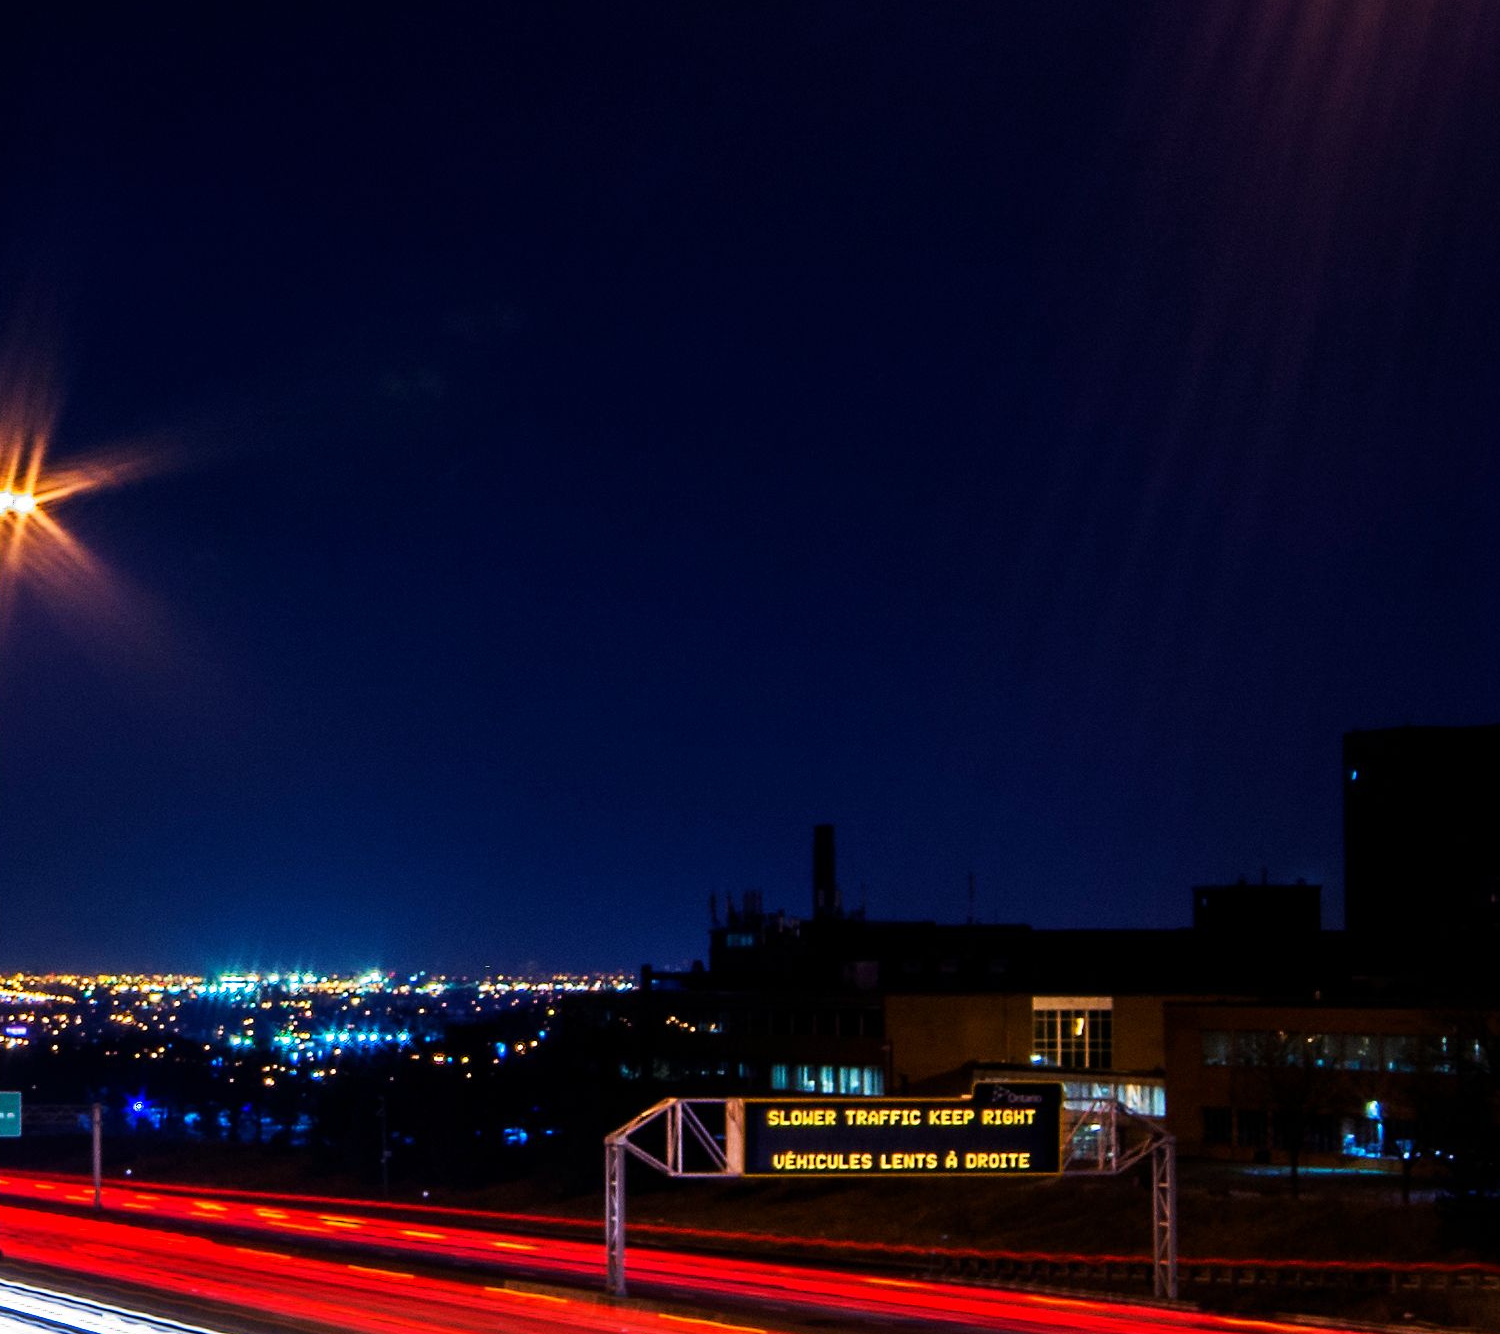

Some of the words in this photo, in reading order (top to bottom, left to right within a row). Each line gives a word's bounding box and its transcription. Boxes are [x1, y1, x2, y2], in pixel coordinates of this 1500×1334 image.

[1007, 1091, 1043, 1104] Ontario
[767, 1108, 837, 1126] SLOWER
[845, 1108, 922, 1126] TRAFFIC
[928, 1108, 975, 1126] KEEP
[981, 1108, 1037, 1126] RIGHT
[772, 1150, 873, 1170] VÉHICULES
[880, 1152, 938, 1170] LENTS
[945, 1150, 959, 1169] À
[965, 1152, 1031, 1170] DROITE
